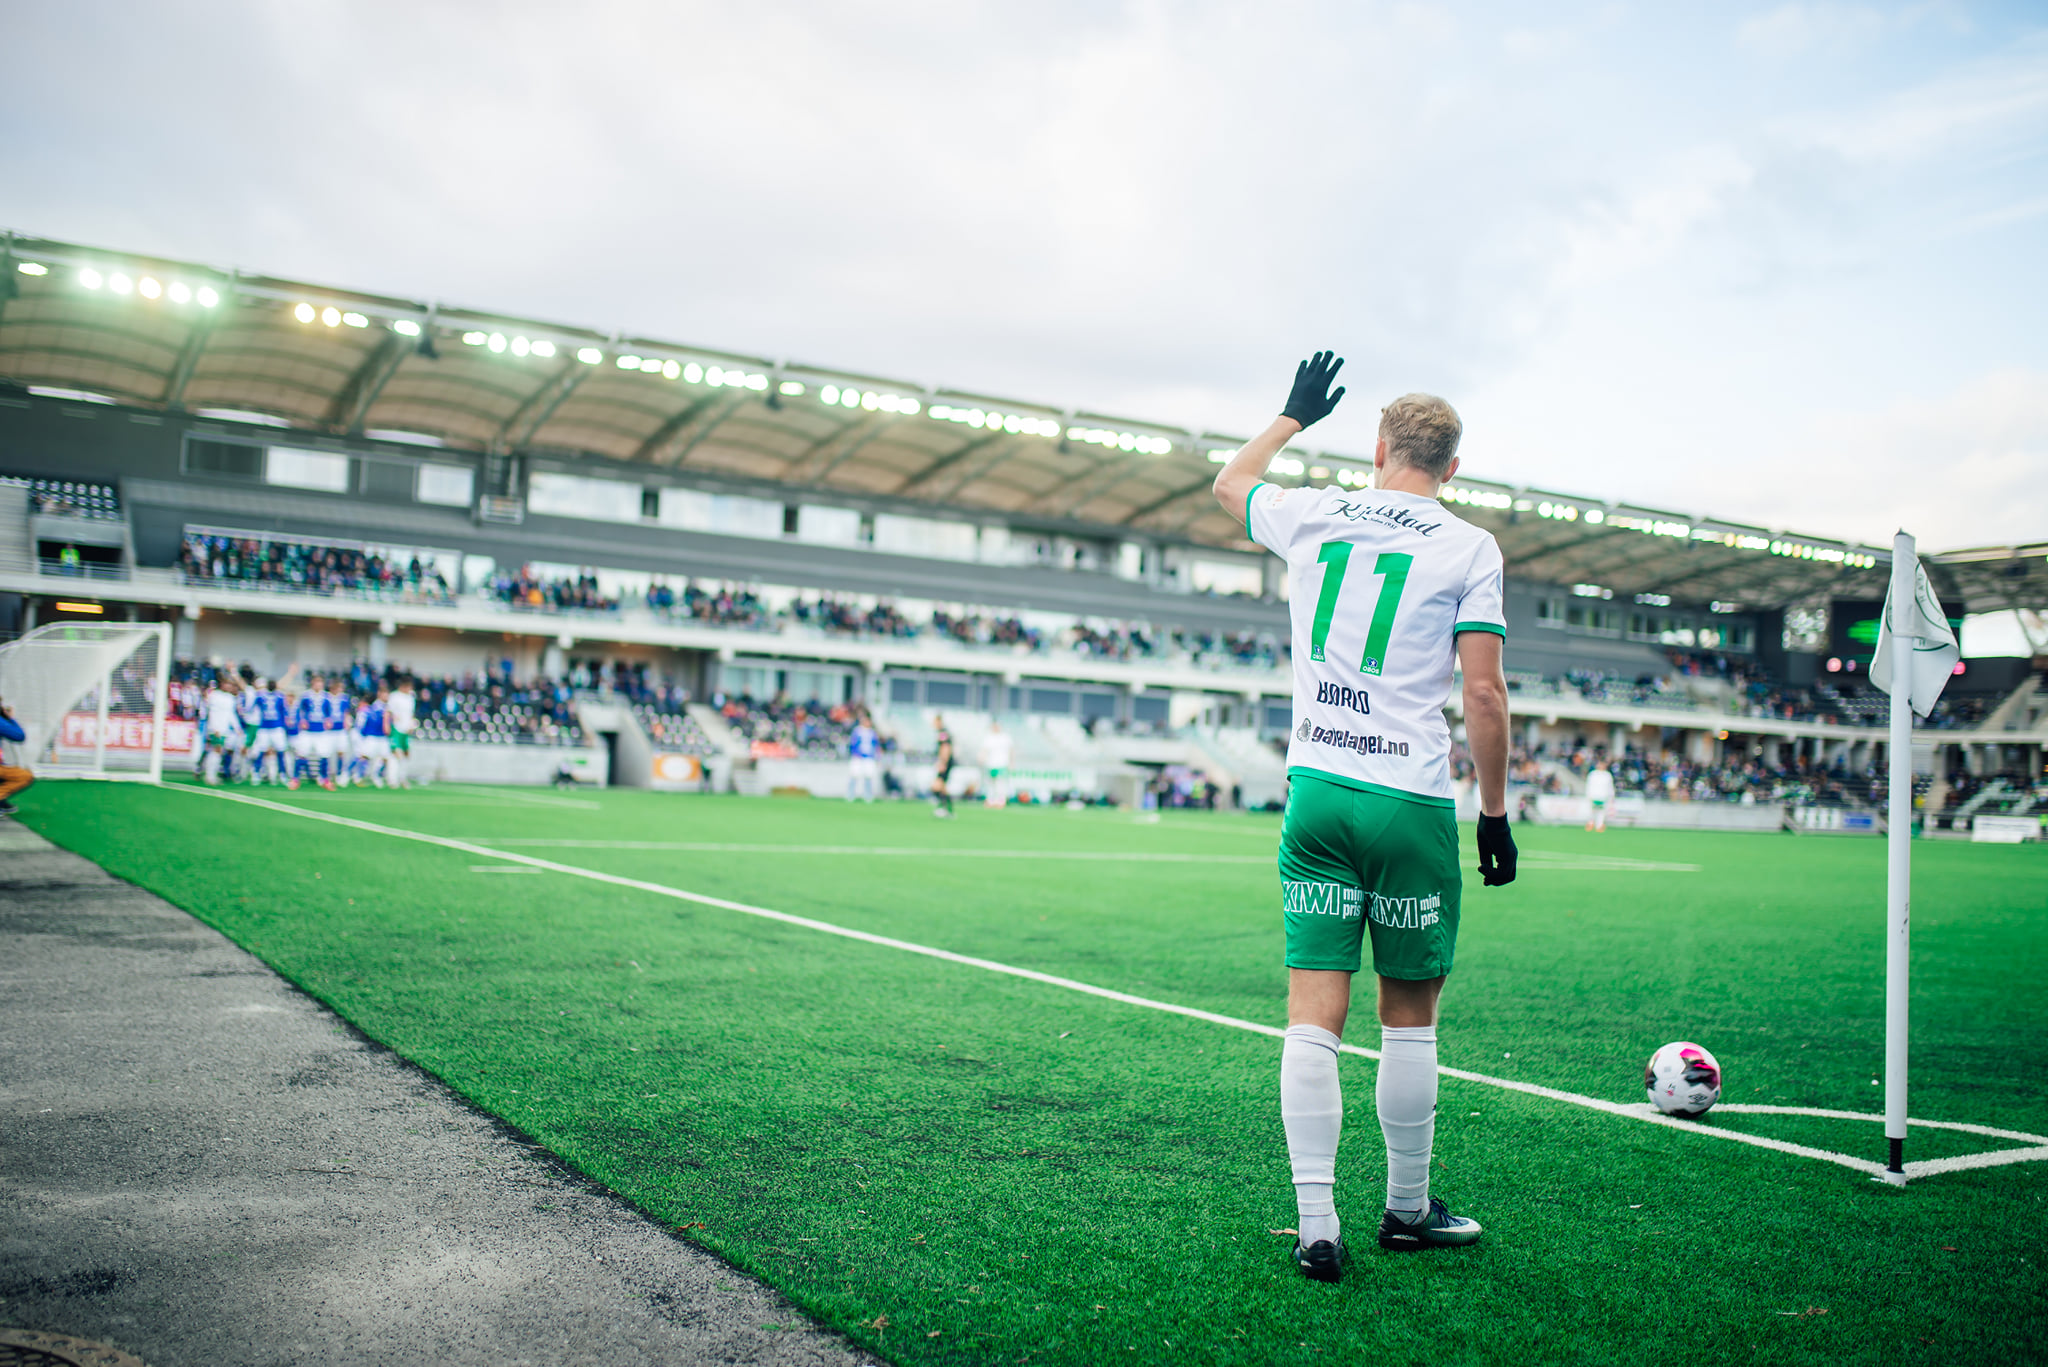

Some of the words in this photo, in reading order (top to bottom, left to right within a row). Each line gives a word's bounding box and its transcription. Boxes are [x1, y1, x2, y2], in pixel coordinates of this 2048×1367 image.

[1310, 541, 1414, 676] 11
[1362, 665, 1380, 675] OBOS
[1283, 881, 1340, 915] KIWI
[1343, 886, 1363, 901] min
[1420, 892, 1440, 911] mini
[1342, 902, 1361, 919] pris
[1421, 909, 1439, 930] pris
